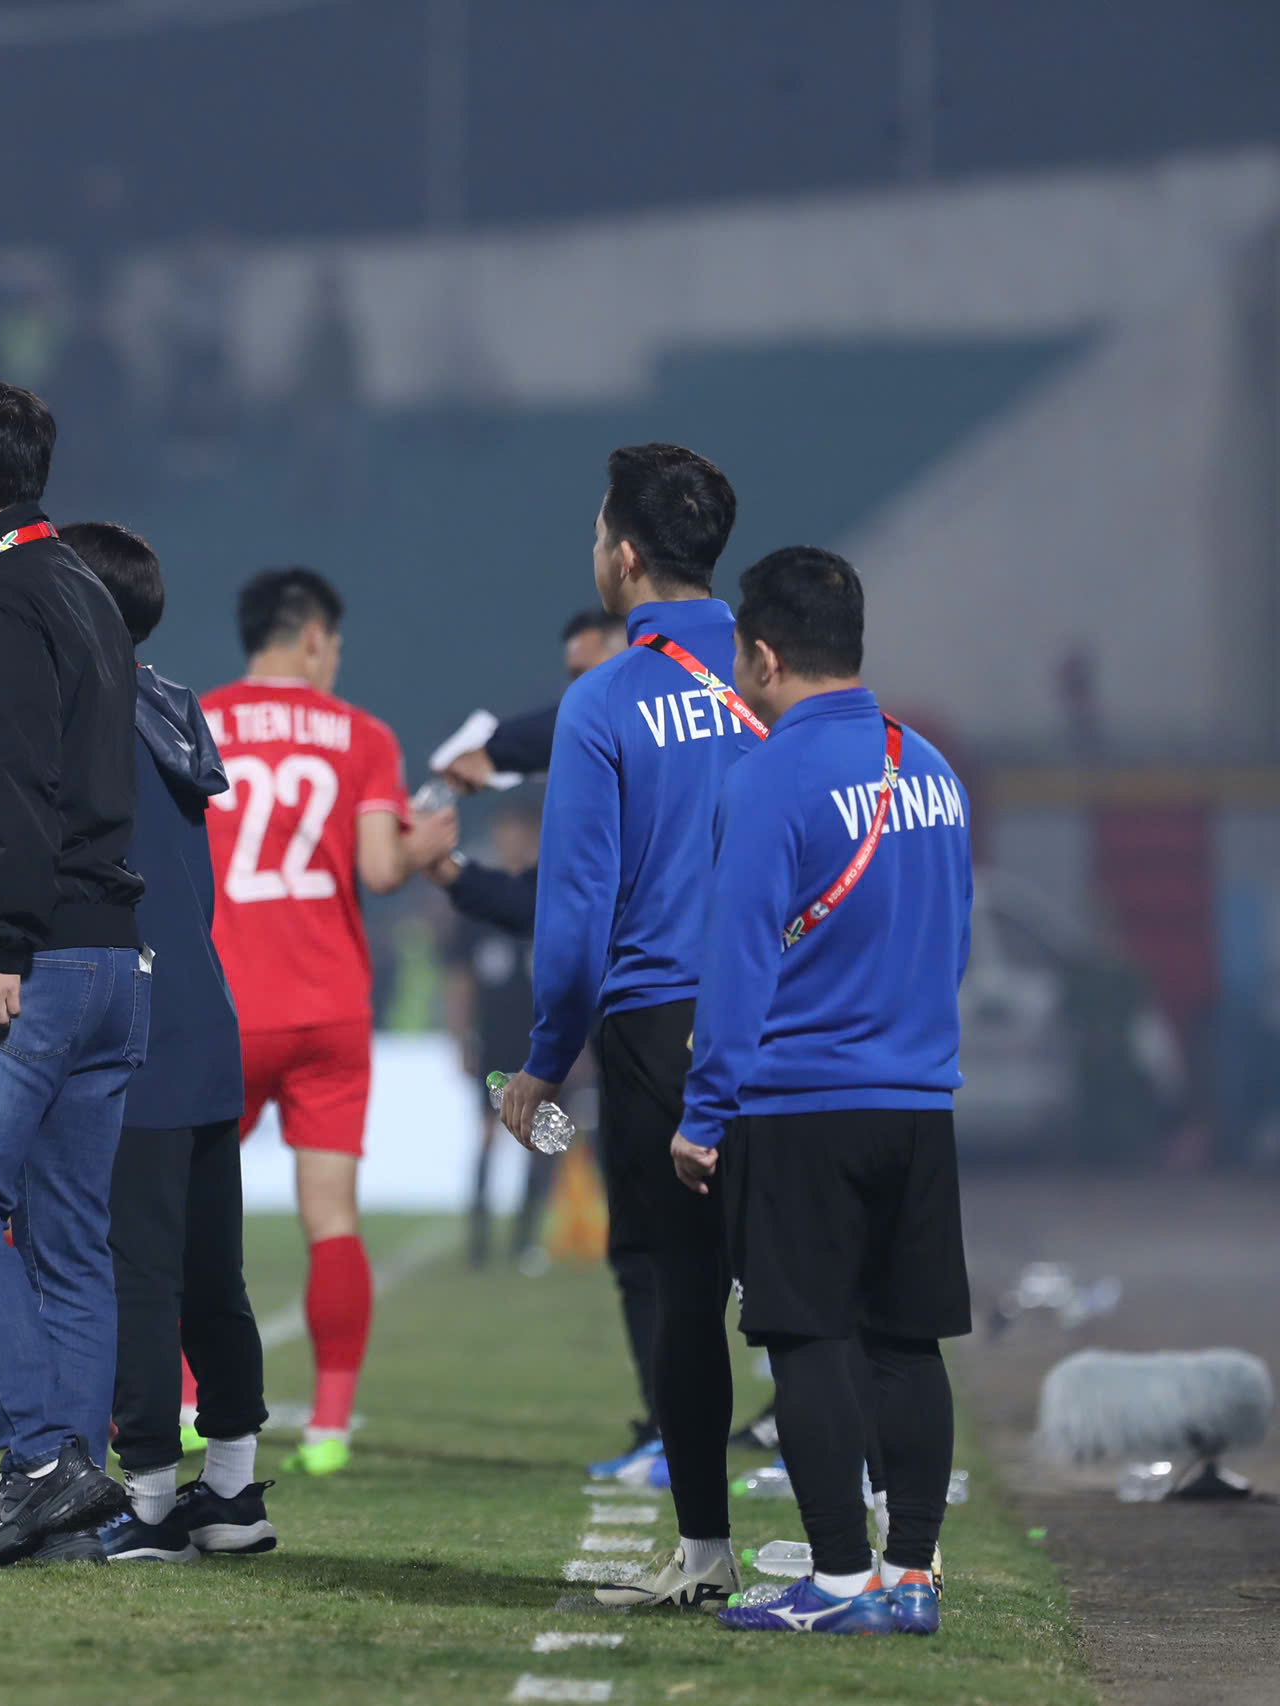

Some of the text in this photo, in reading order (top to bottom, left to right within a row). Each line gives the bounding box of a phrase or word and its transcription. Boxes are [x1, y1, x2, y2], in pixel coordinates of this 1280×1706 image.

[232, 700, 291, 744] TIEN
[637, 689, 742, 748] VIET
[210, 754, 338, 904] 22
[844, 868, 858, 886] CUP
